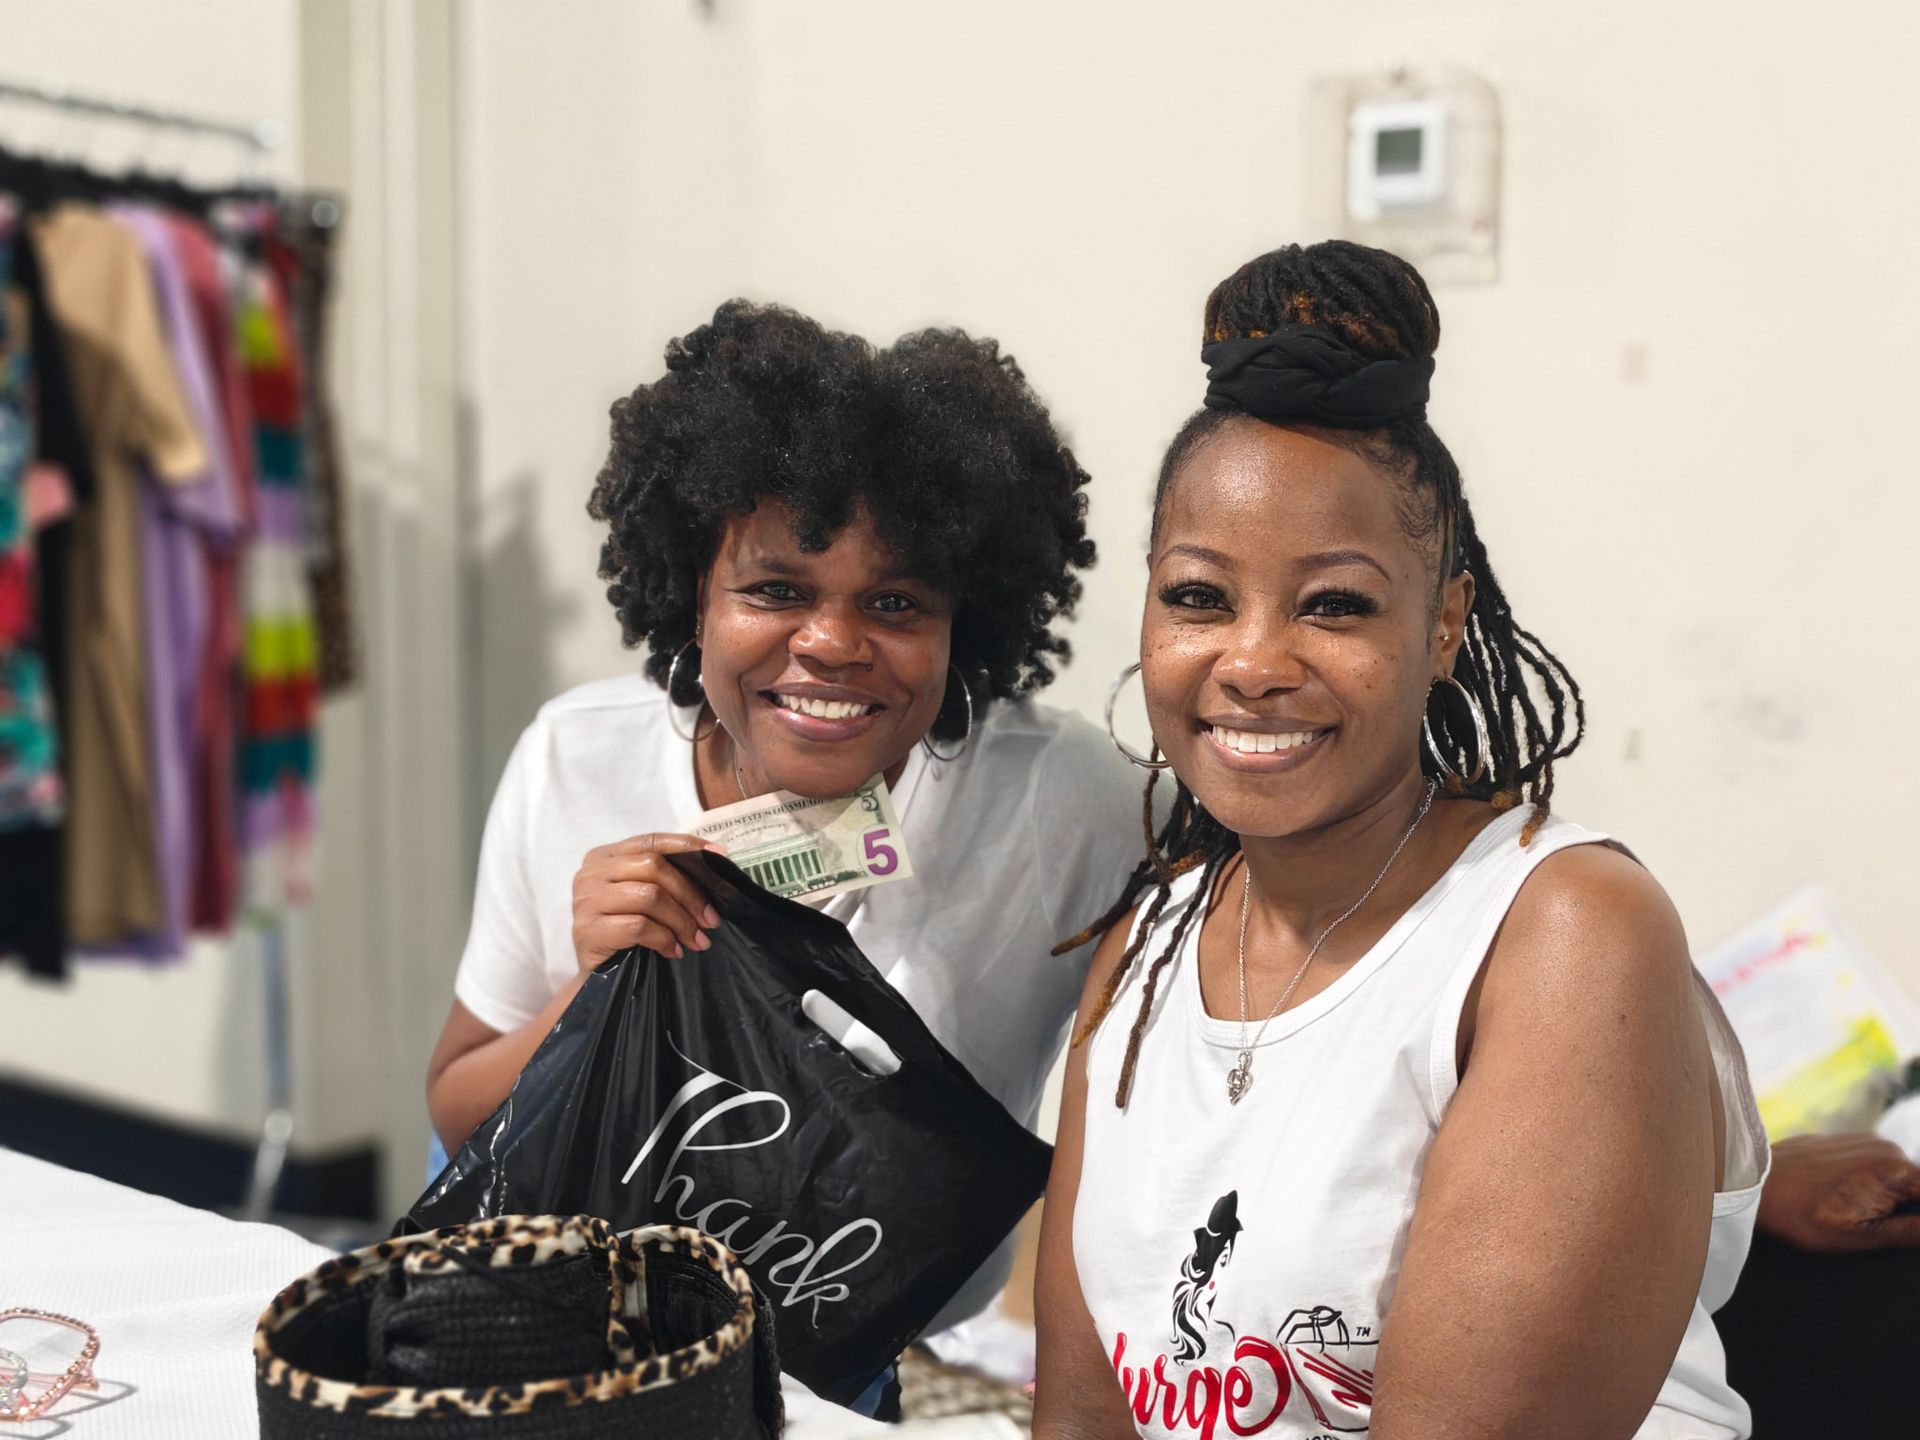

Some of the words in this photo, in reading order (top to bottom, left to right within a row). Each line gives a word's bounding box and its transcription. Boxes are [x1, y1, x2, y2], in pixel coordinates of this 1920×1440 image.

[733, 809, 772, 825] STATES
[863, 828, 898, 876] 5
[621, 1030, 883, 1329] Thank
[1356, 1326, 1371, 1337] TM
